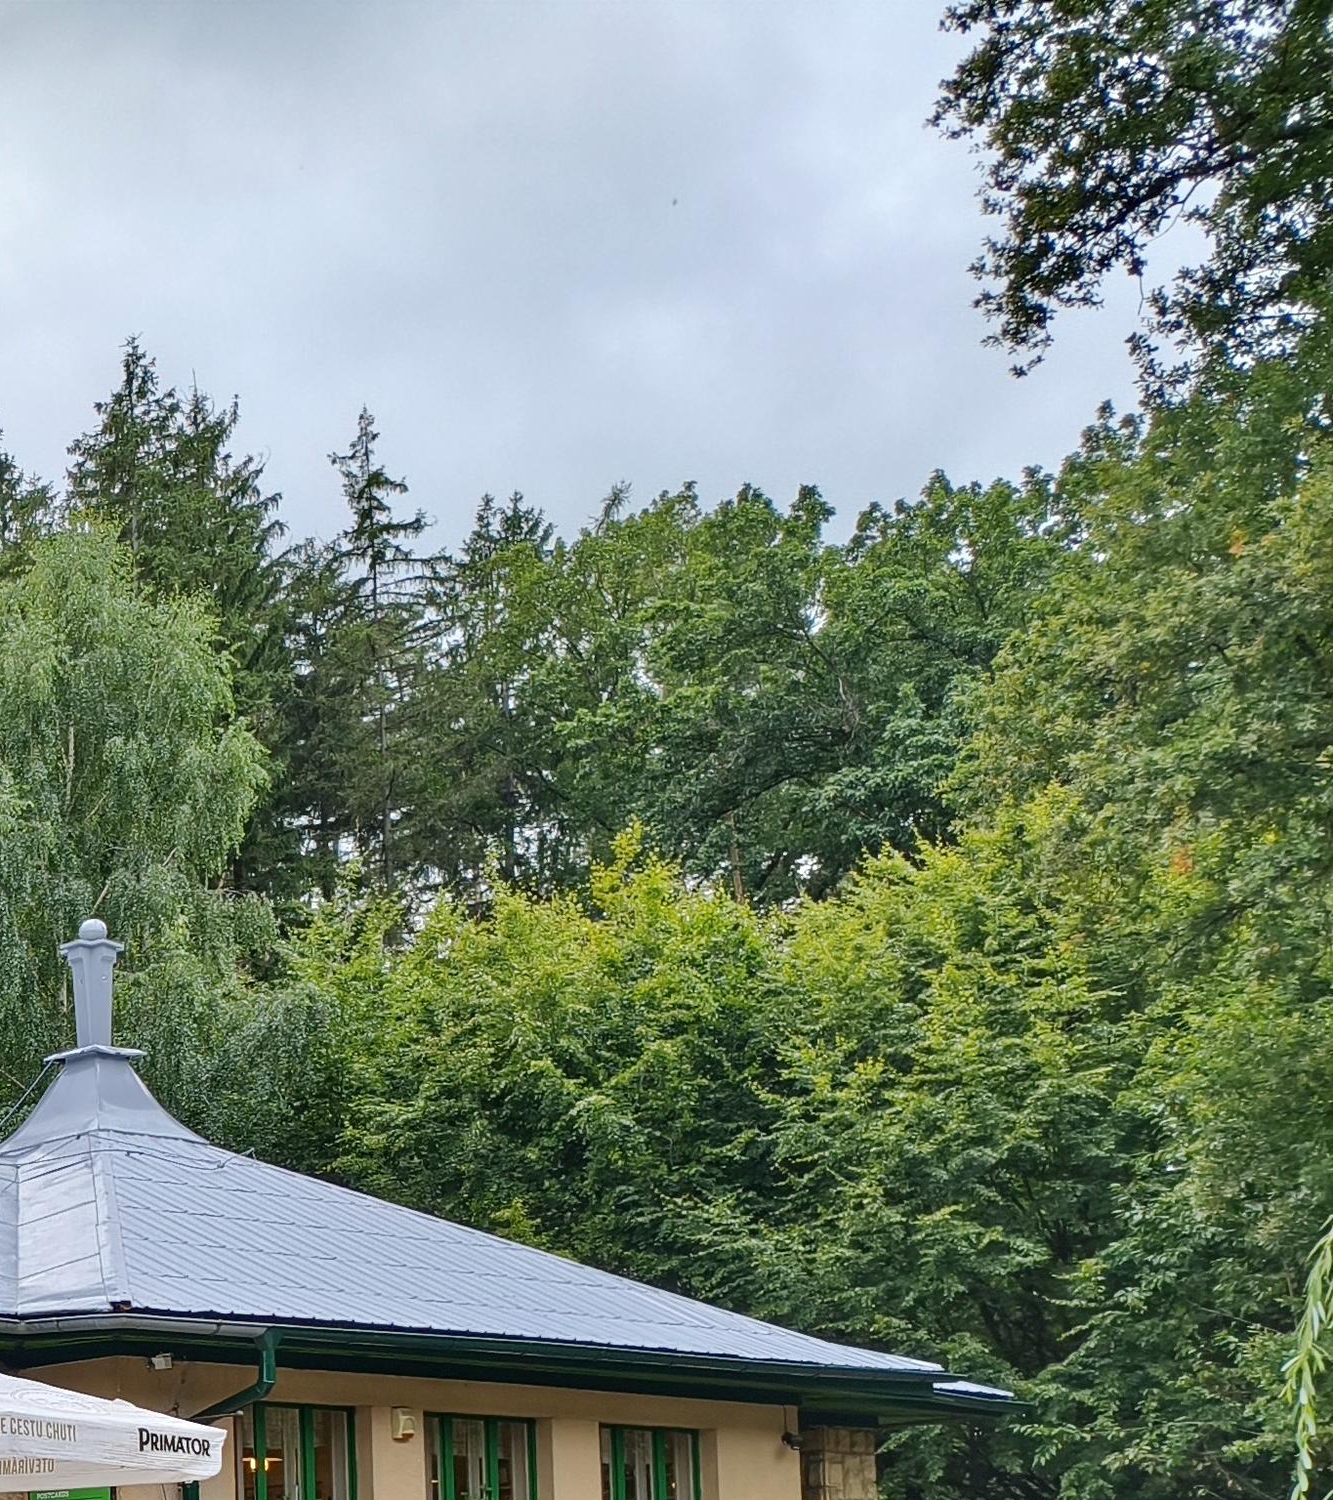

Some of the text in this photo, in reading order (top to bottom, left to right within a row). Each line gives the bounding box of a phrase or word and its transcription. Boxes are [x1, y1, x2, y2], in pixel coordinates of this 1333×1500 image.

[10, 1419, 43, 1438] CESTU
[46, 1422, 77, 1442] CHUTI
[138, 1428, 211, 1457] PRIMATOR
